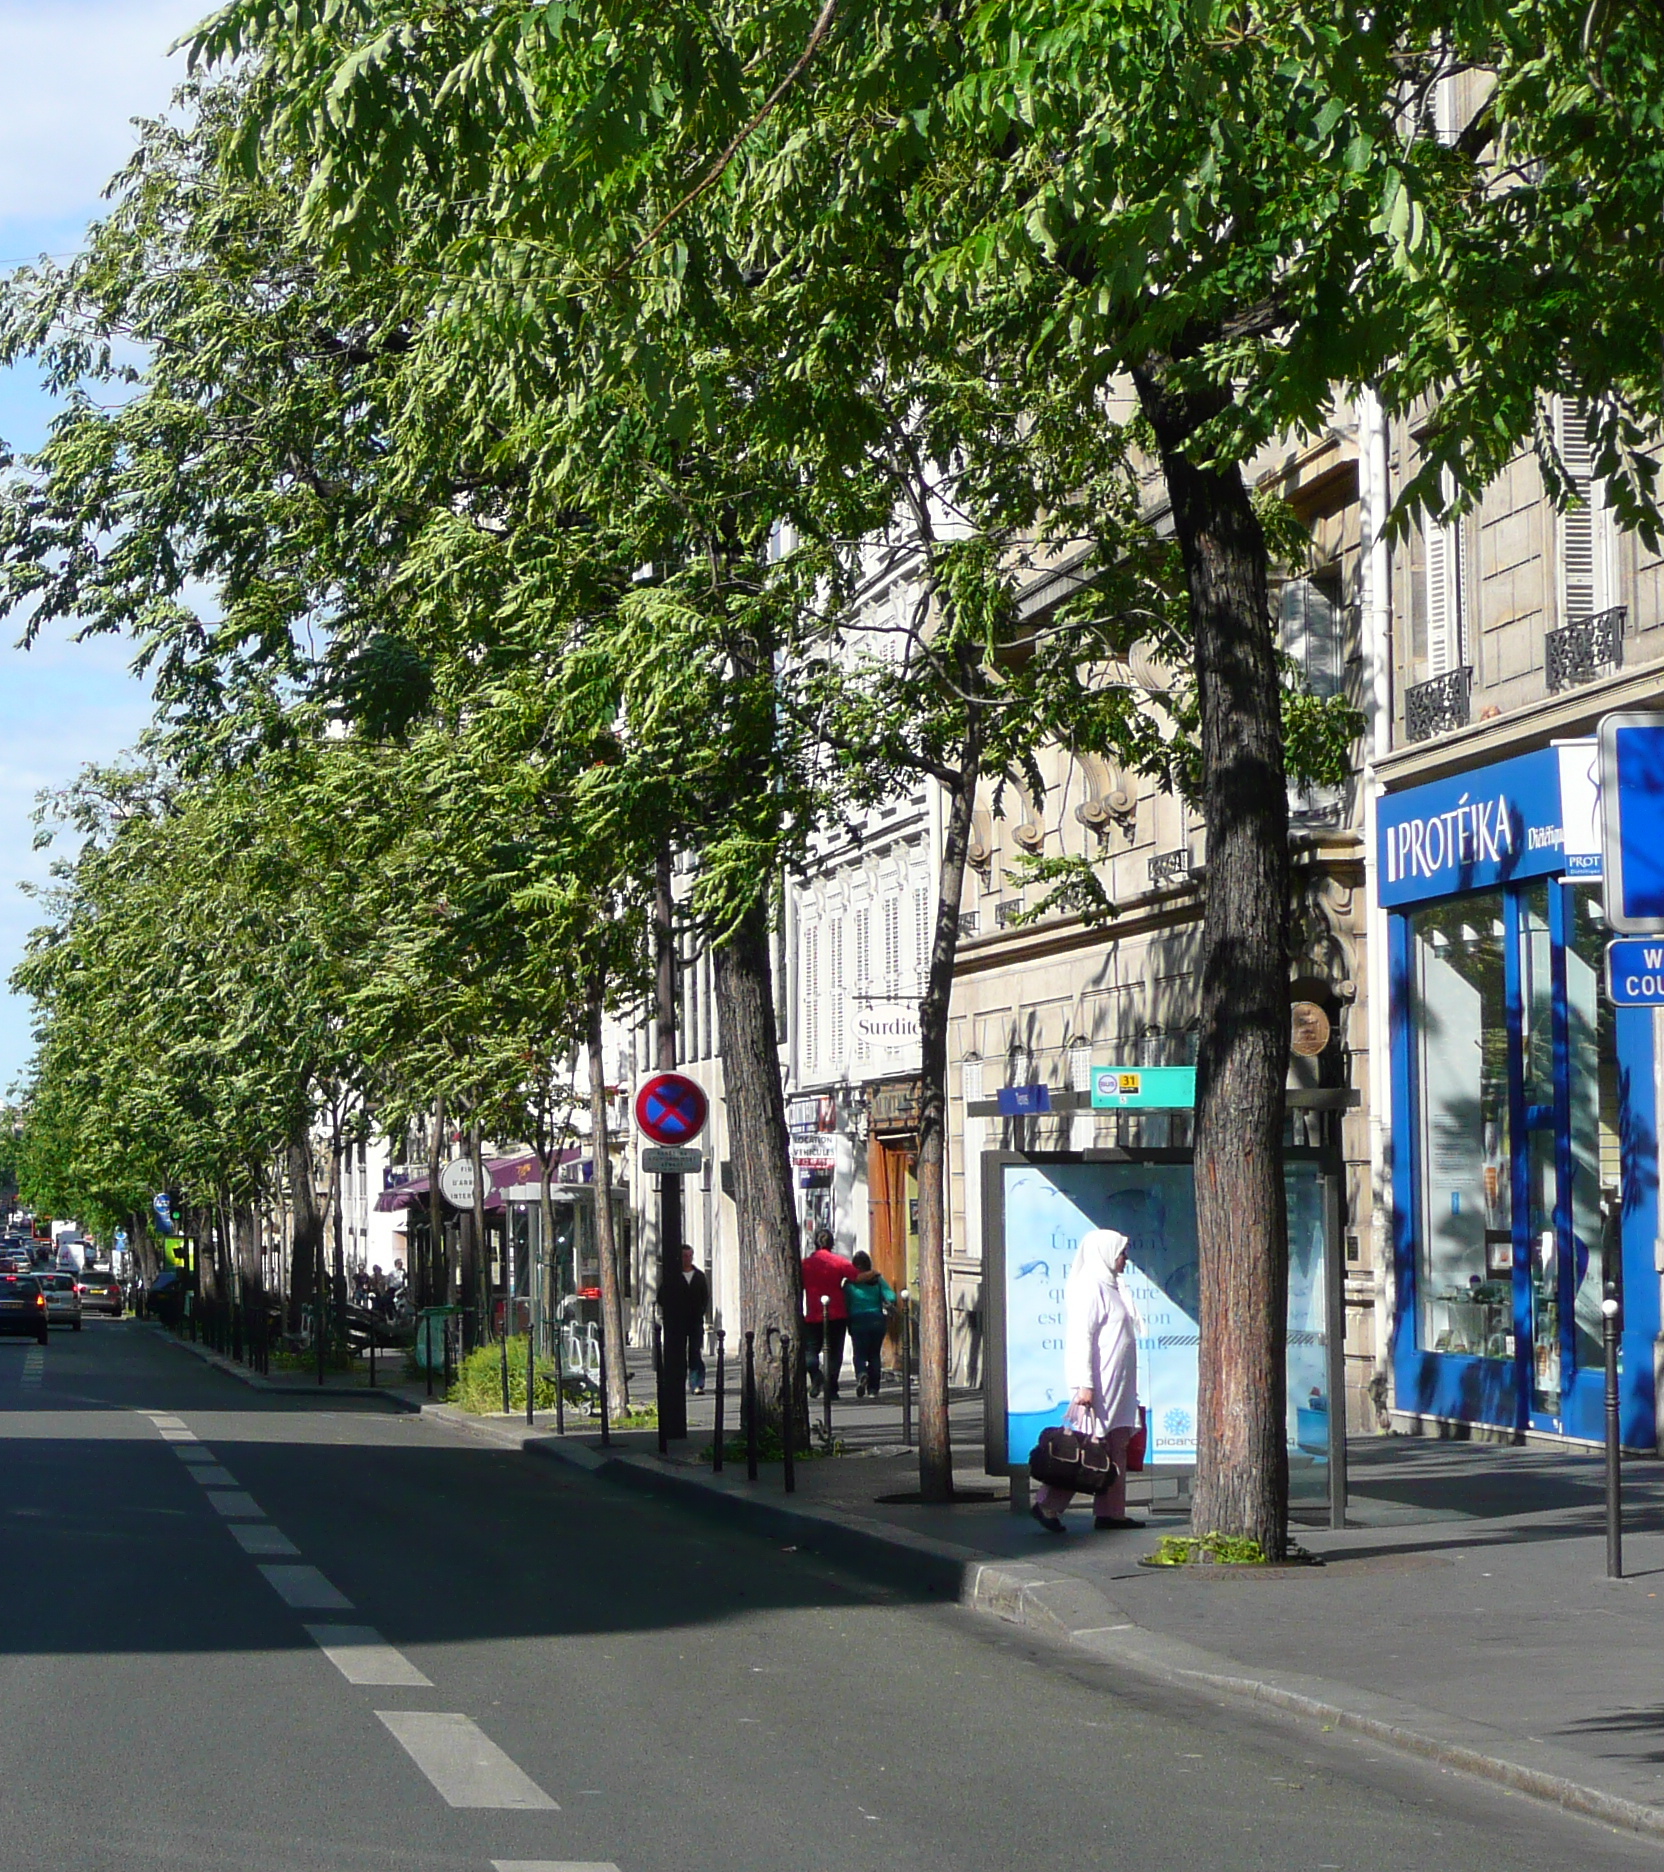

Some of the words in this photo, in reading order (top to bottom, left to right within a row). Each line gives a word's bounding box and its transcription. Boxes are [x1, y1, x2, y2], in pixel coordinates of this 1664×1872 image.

[1569, 856, 1601, 867] PROT
[1626, 976, 1664, 996] COU
[1123, 1075, 1135, 1086] 31
[1037, 1312, 1062, 1325] est
